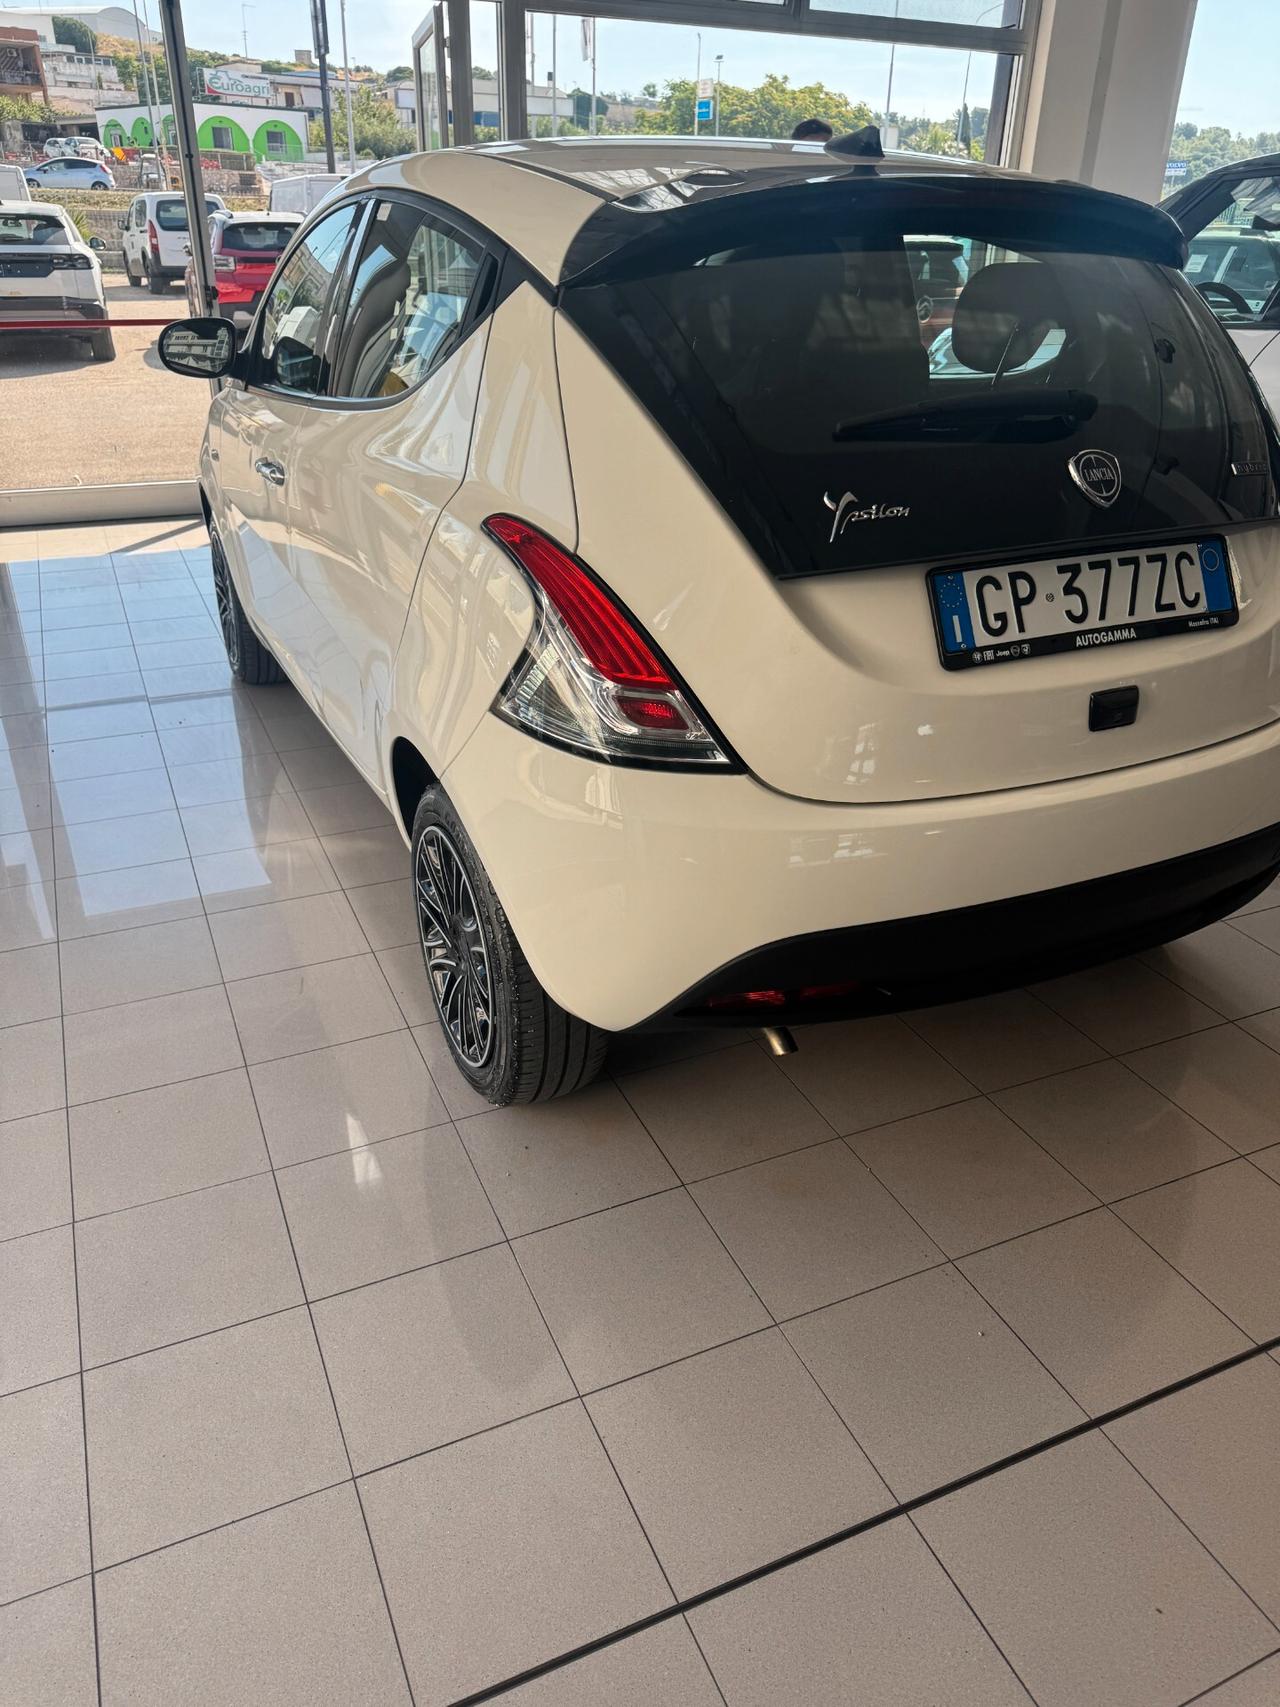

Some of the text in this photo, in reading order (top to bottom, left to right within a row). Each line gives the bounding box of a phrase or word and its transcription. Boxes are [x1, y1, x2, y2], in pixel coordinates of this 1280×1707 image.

[208, 75, 270, 96] Euroagri
[1084, 468, 1114, 481] LANCIA
[824, 491, 910, 543] Ypsilon
[975, 551, 1201, 637] GP 377ZC
[1075, 627, 1137, 647] AUTOGAMMA
